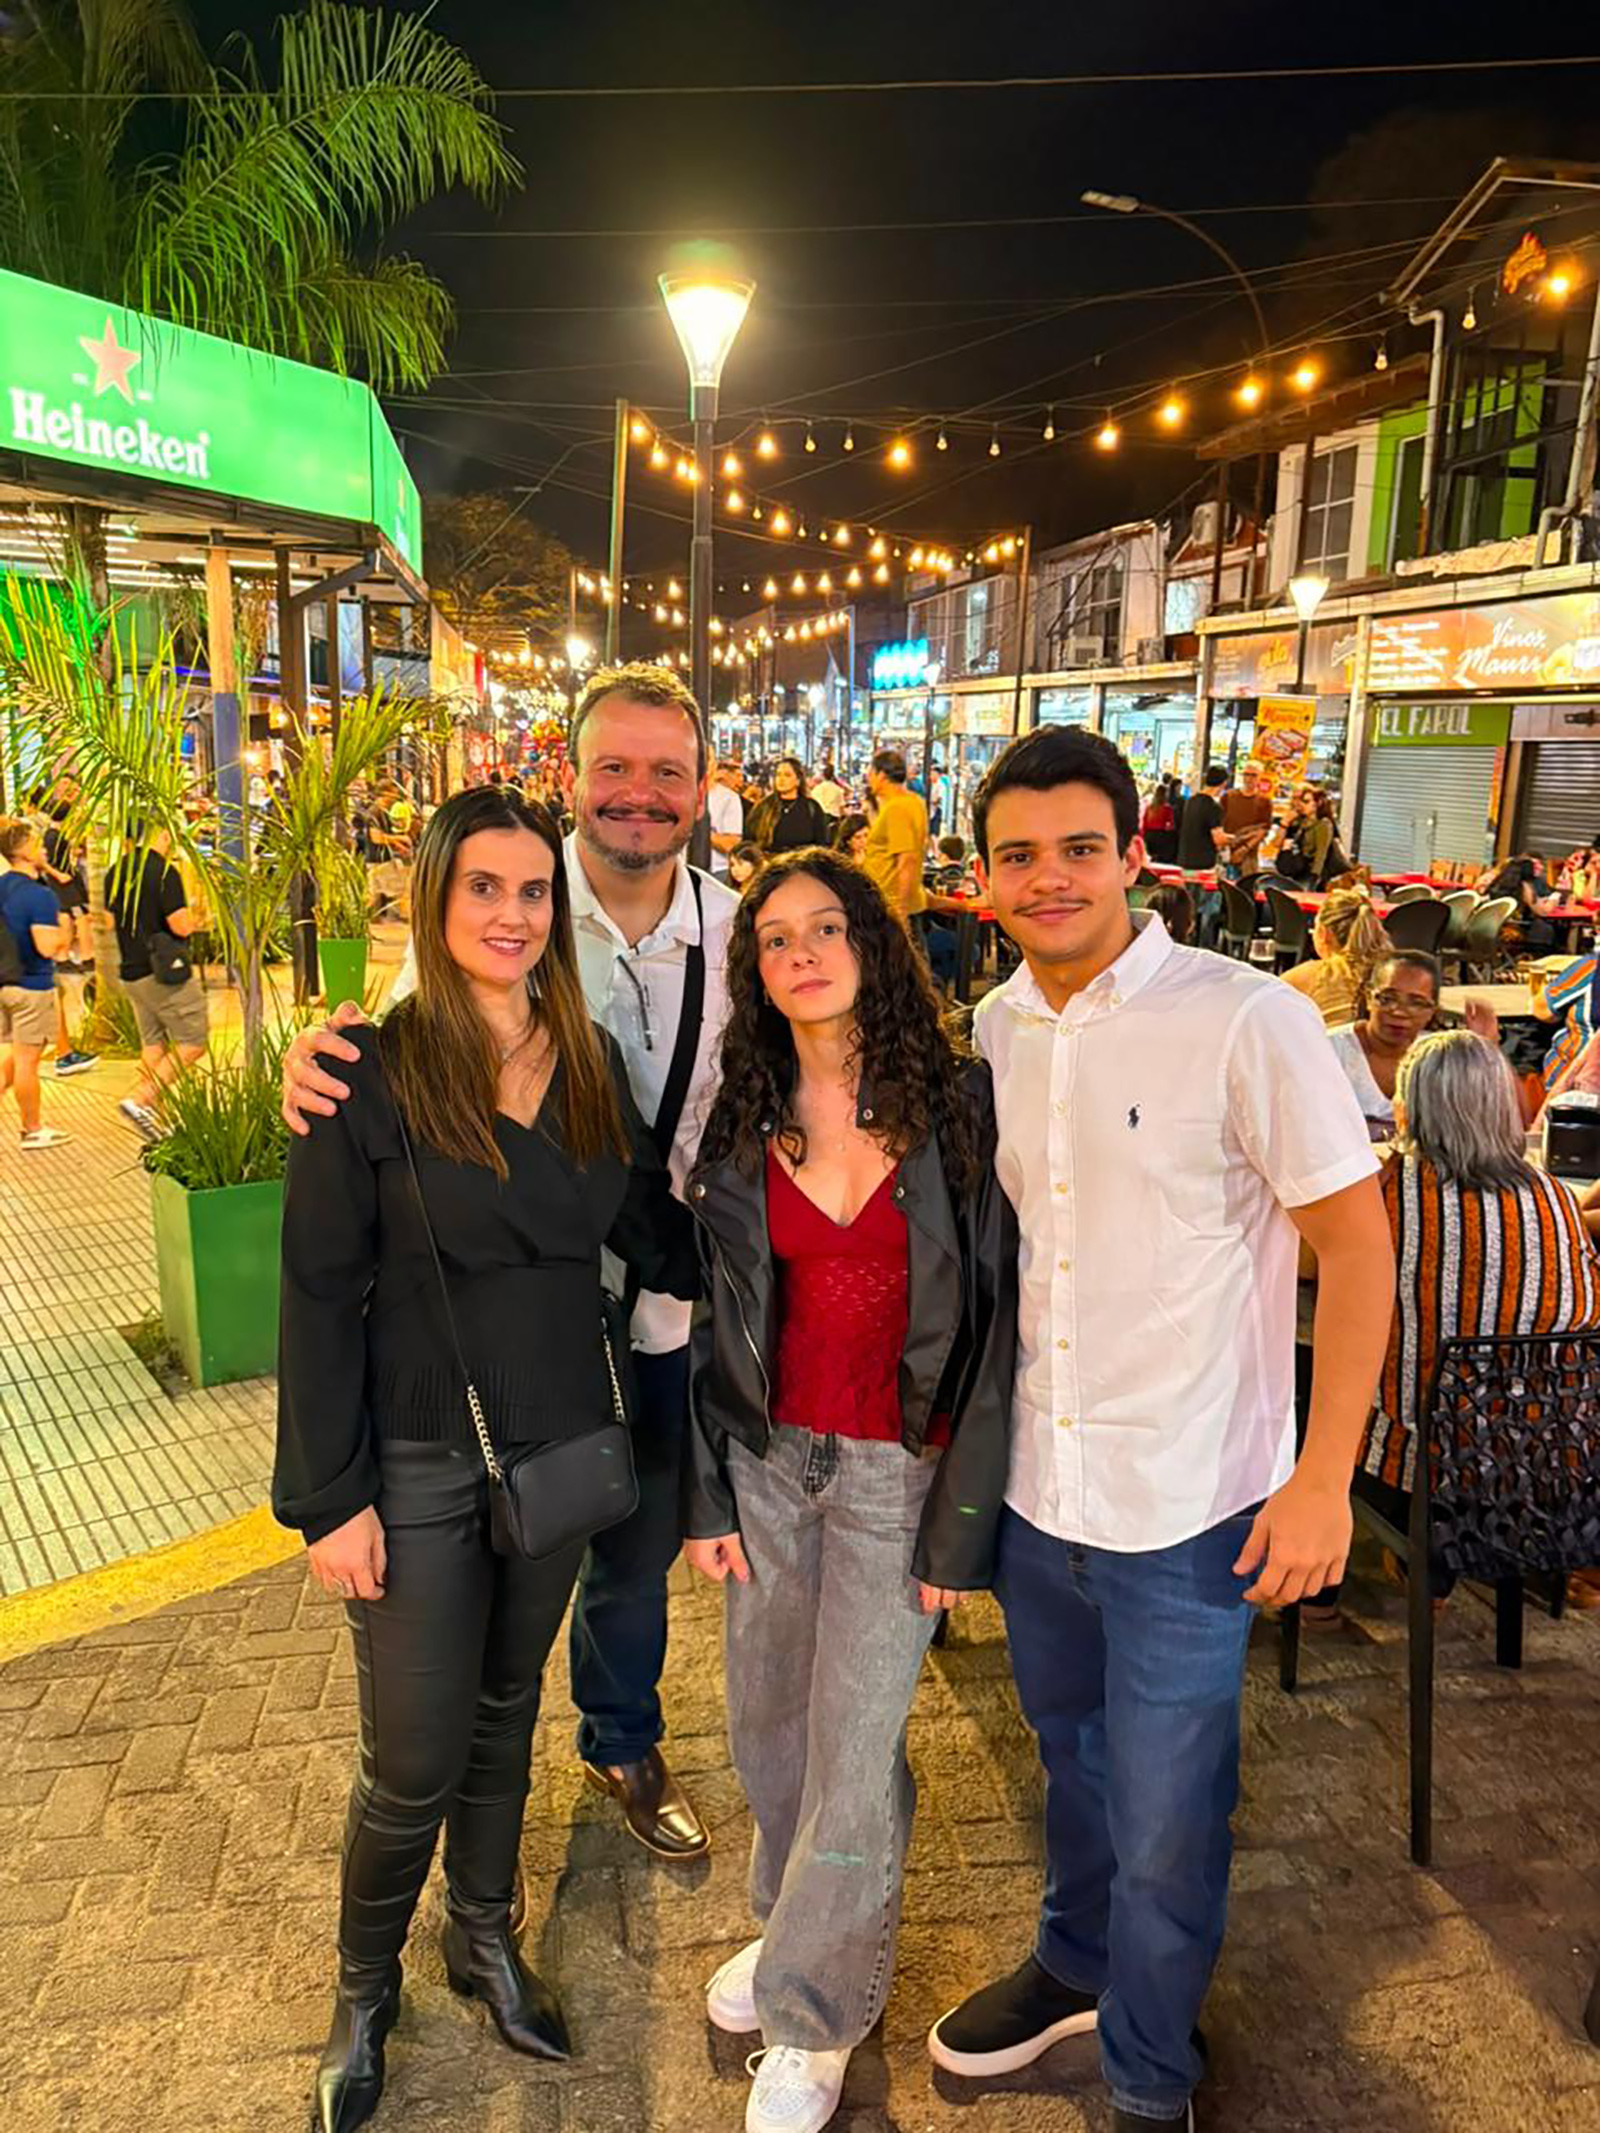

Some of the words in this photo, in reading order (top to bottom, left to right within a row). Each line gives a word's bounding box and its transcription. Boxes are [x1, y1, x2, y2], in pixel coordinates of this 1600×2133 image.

[9, 387, 211, 480] Heineken
[1381, 706, 1402, 736] EL
[1408, 705, 1473, 736] FAROL
